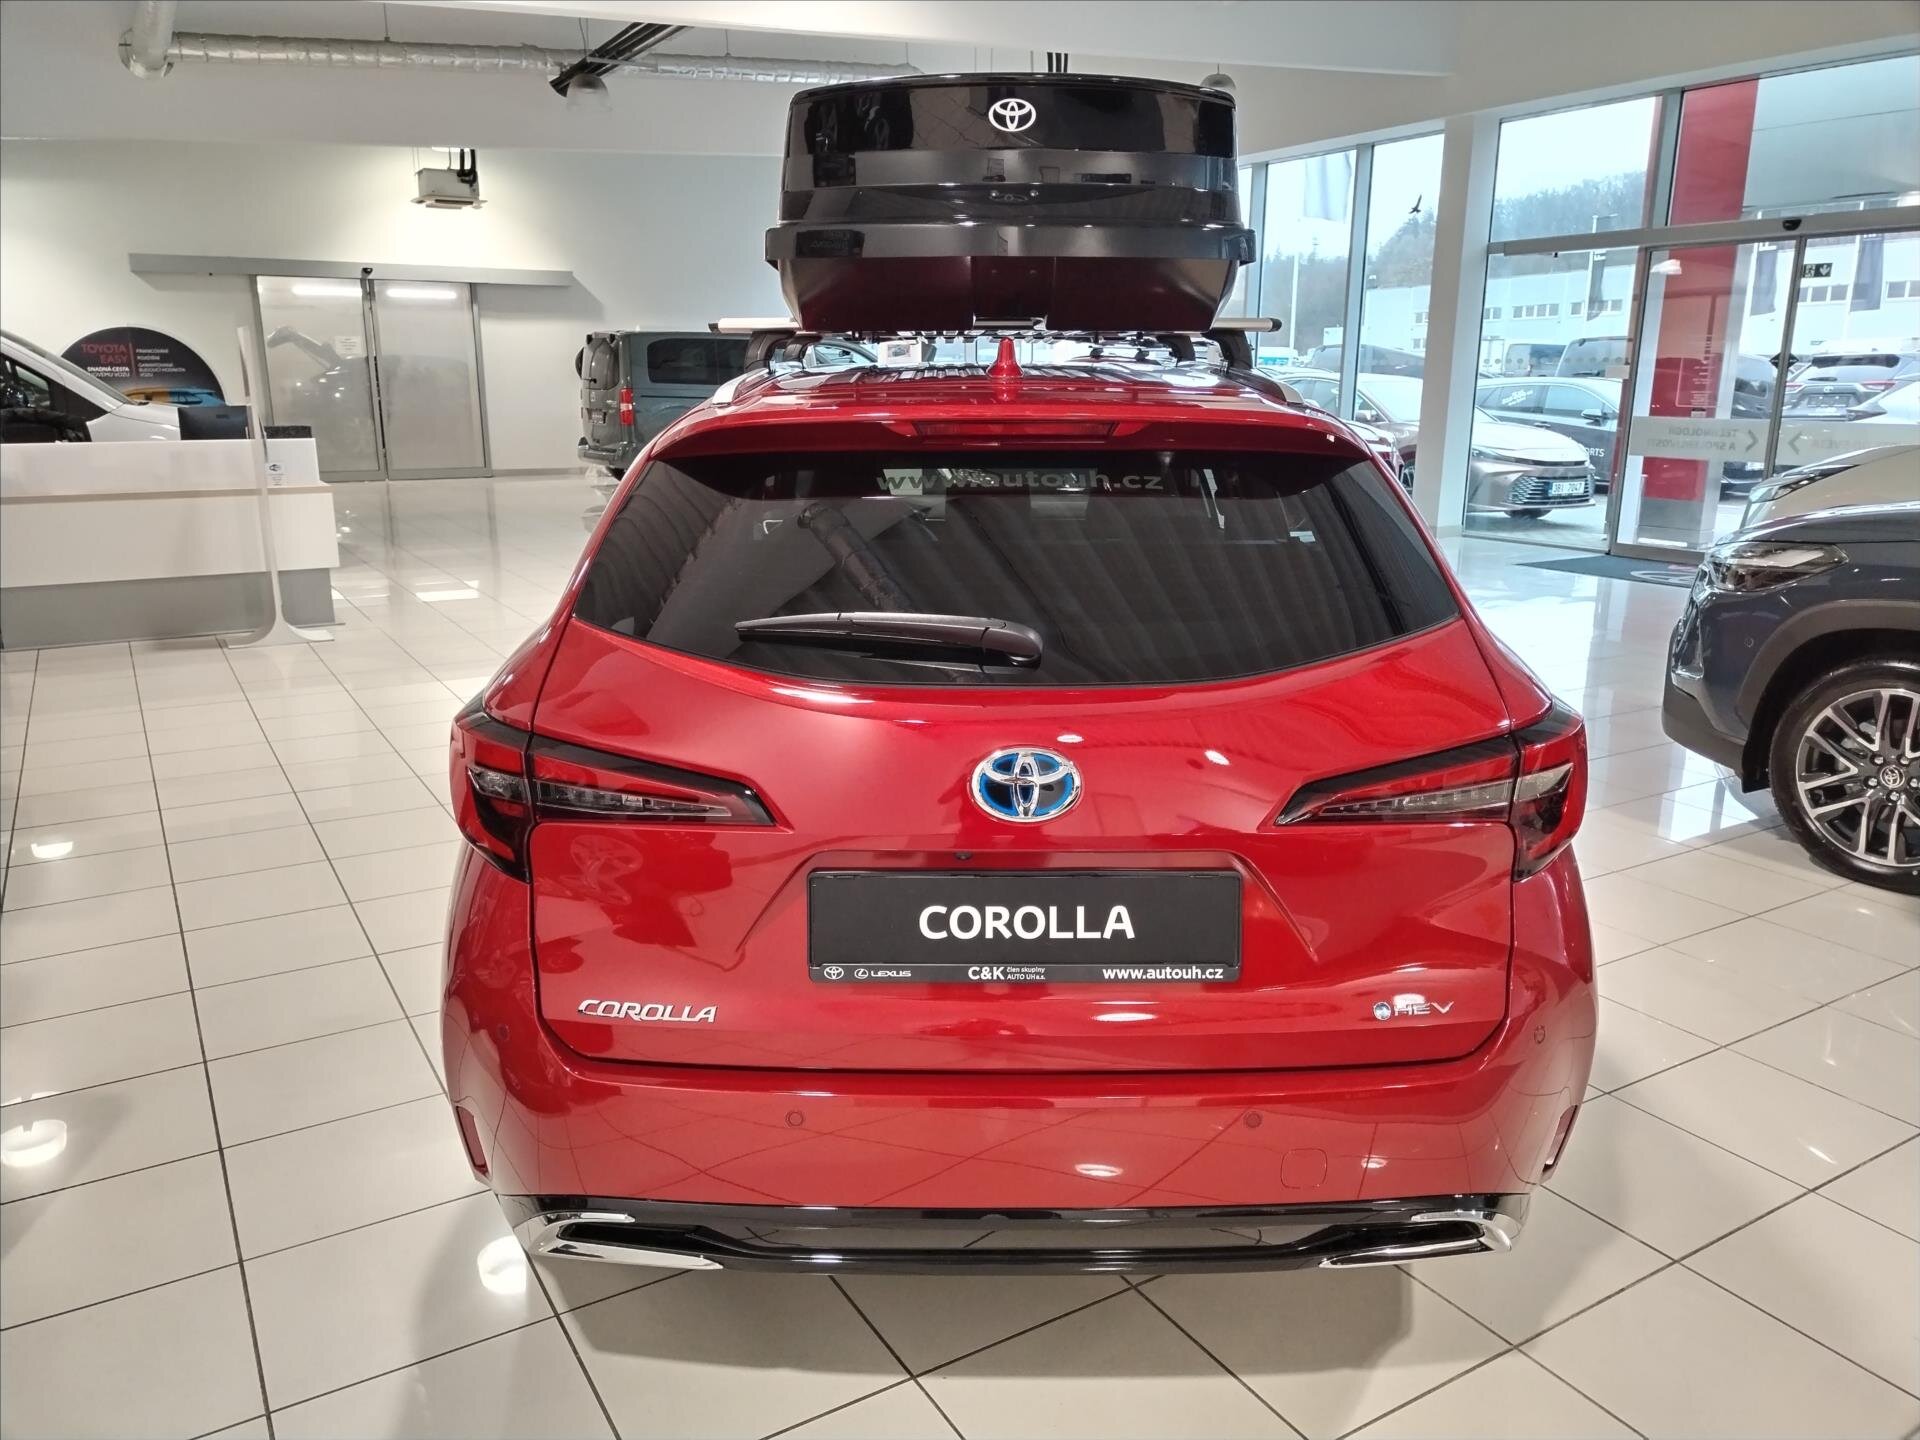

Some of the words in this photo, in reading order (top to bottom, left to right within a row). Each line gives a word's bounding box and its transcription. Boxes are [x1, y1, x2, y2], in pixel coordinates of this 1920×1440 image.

[80, 343, 128, 354] TOYOTA
[100, 355, 128, 364] EASY
[919, 905, 1135, 939] COROLLA
[968, 966, 1005, 980] C&K
[1102, 966, 1224, 980] www.autouh.cz
[578, 999, 718, 1023] COROLLA
[1393, 1000, 1455, 1016] HEV
